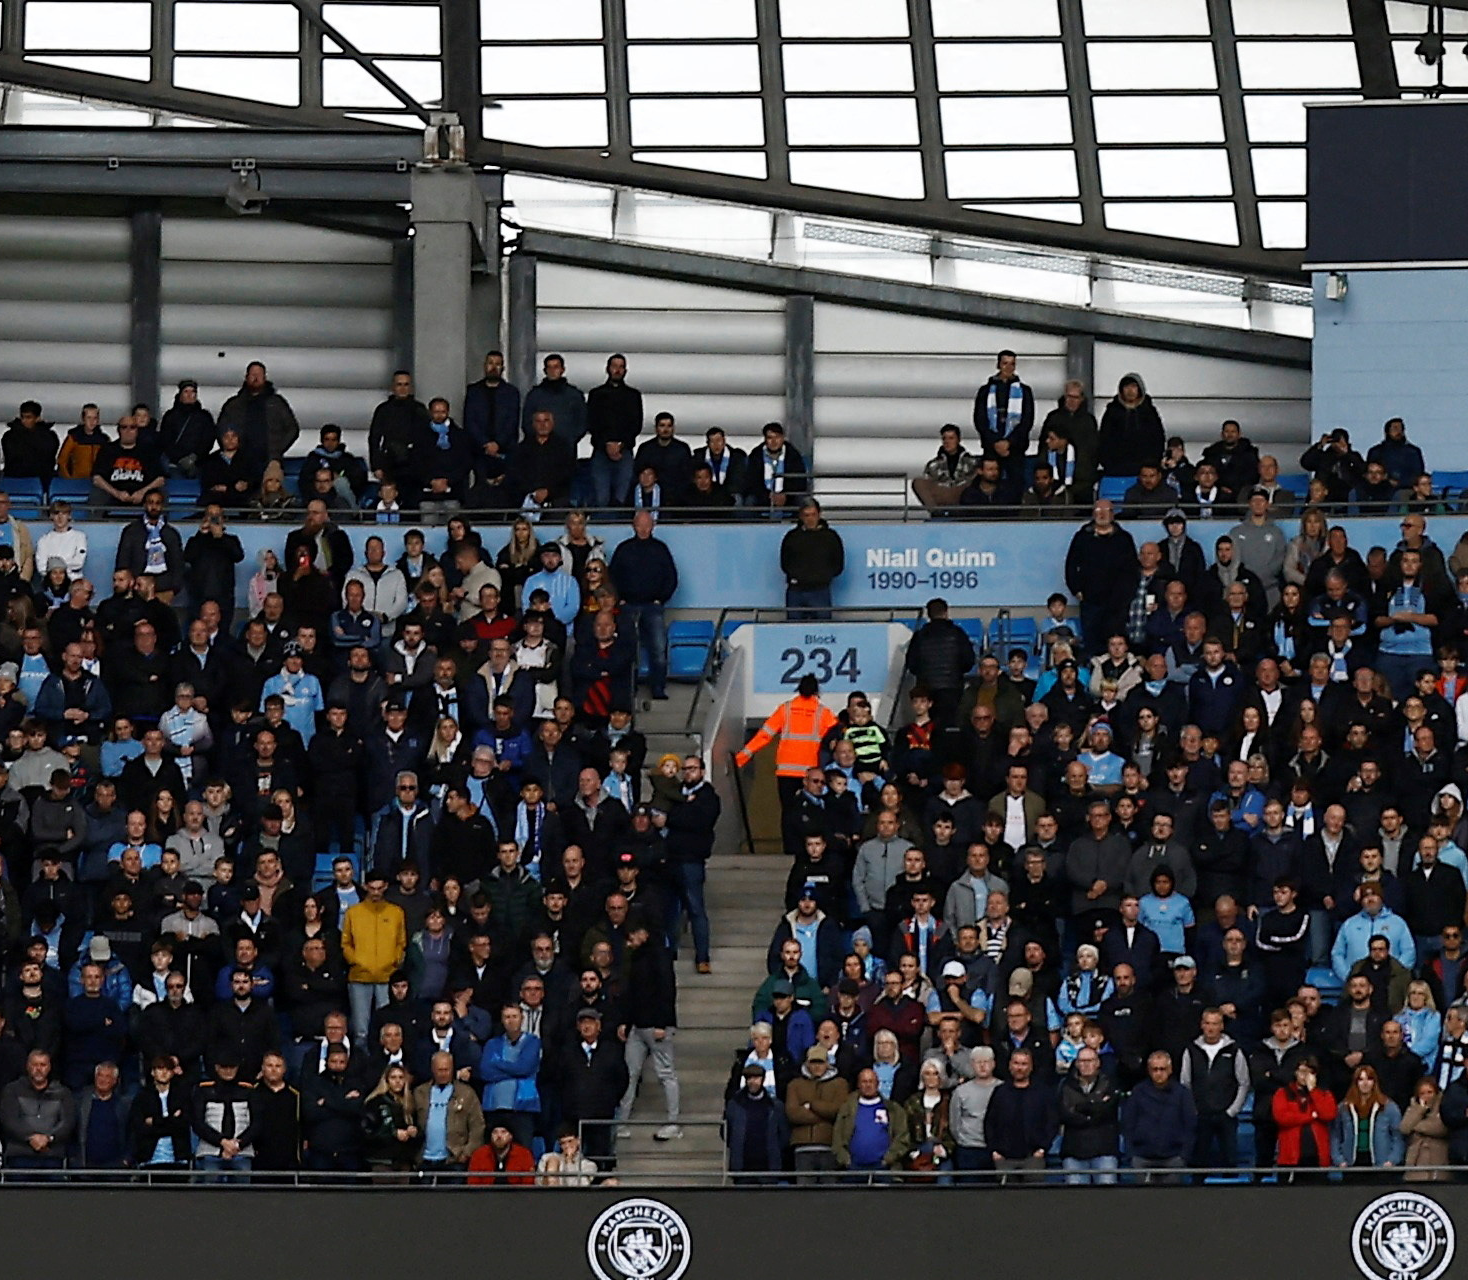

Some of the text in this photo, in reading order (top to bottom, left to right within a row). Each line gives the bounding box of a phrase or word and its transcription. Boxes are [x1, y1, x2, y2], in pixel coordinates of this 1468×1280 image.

[866, 547, 996, 569] Niall Quinn
[804, 633, 837, 646] Block
[780, 646, 862, 684] 234
[601, 1206, 678, 1237] MANCHESTER
[1365, 1200, 1442, 1231] MANCHESTER
[1388, 1271, 1418, 1280] CITY
